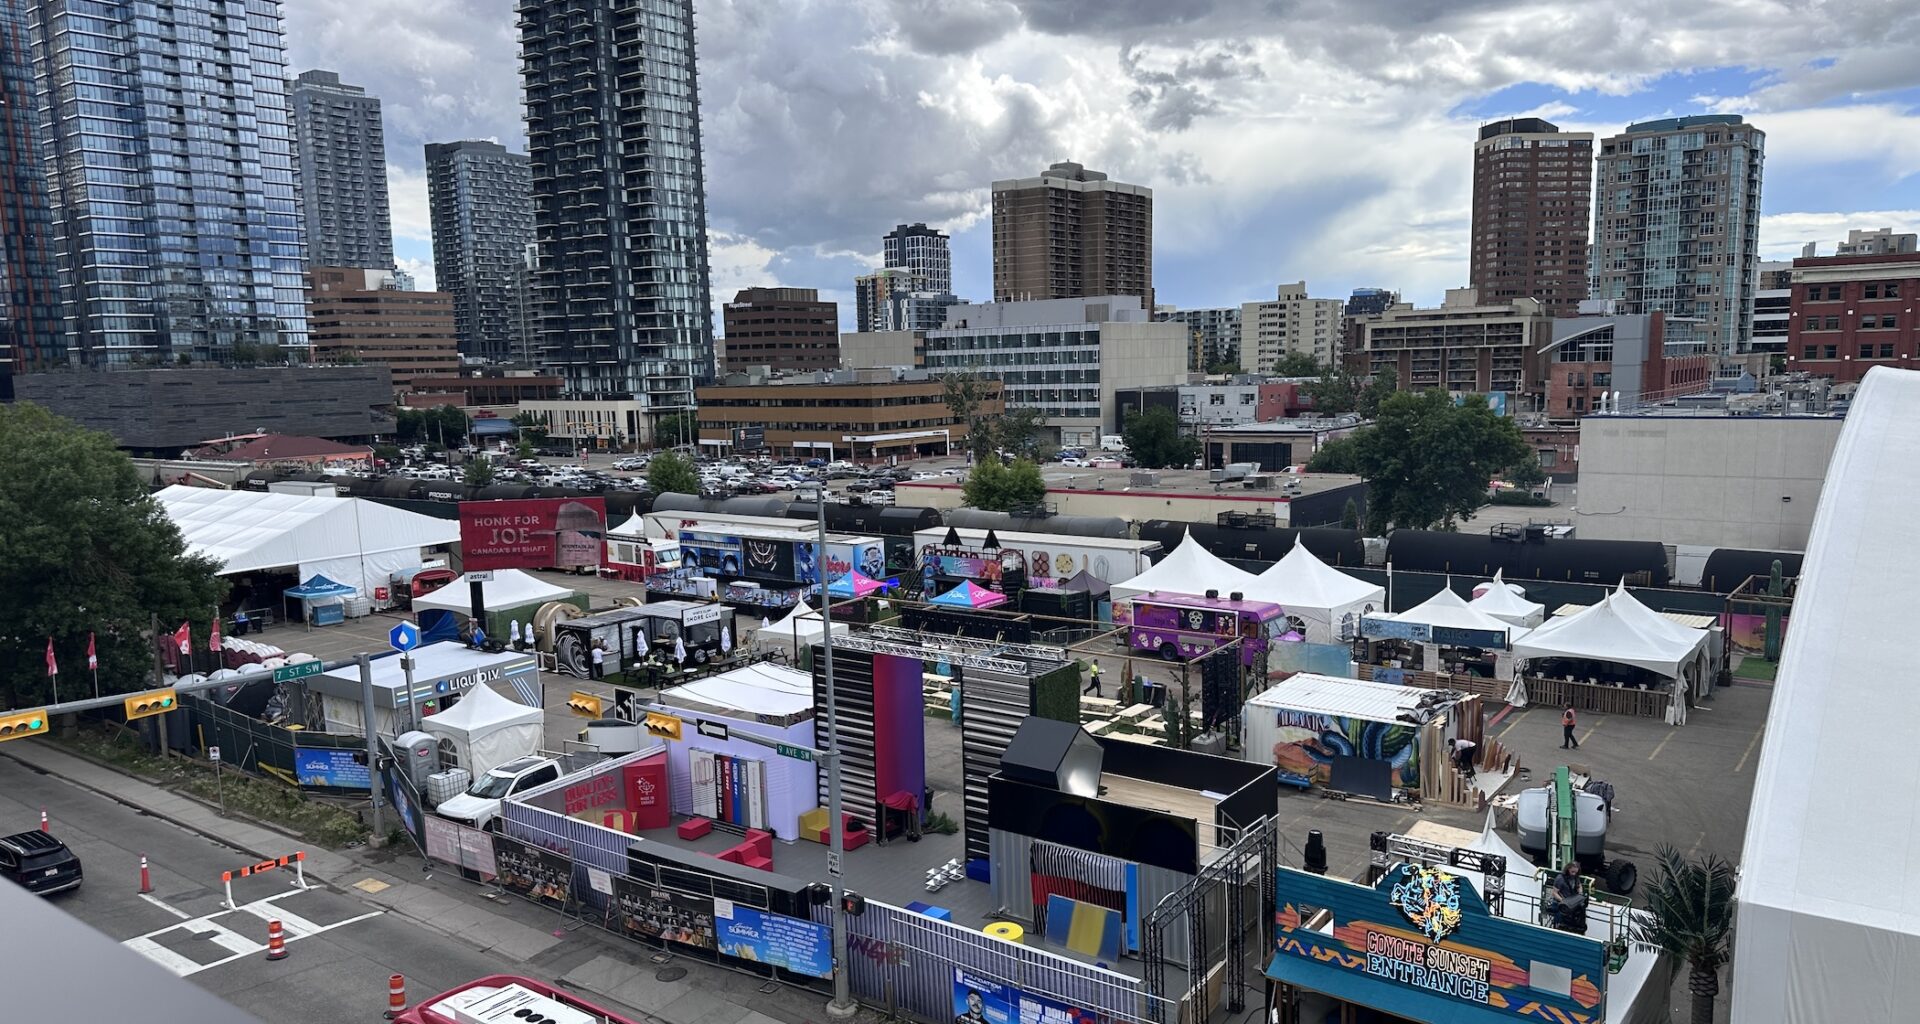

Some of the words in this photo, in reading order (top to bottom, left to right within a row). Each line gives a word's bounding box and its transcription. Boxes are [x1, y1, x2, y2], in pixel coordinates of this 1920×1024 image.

[429, 491, 452, 500] PROCOR
[474, 517, 511, 527] HONK
[514, 515, 540, 526] FOR
[488, 528, 531, 546] JOE
[471, 546, 511, 556] CANADA'S
[522, 545, 547, 553] SHAFT
[686, 613, 704, 622] SHORE
[706, 611, 718, 619] CLUB
[276, 671, 282, 679] 7
[289, 667, 300, 677] ST
[305, 663, 320, 673] SW
[785, 747, 797, 757] AVE
[801, 750, 811, 760] SW
[565, 798, 588, 814] FOR
[728, 925, 759, 938] SUMMER
[1367, 931, 1425, 965] COYOTE
[1427, 946, 1490, 981] SUNSET
[963, 972, 1002, 991] FOUNDATION
[1366, 953, 1489, 1004] ENTRANCE
